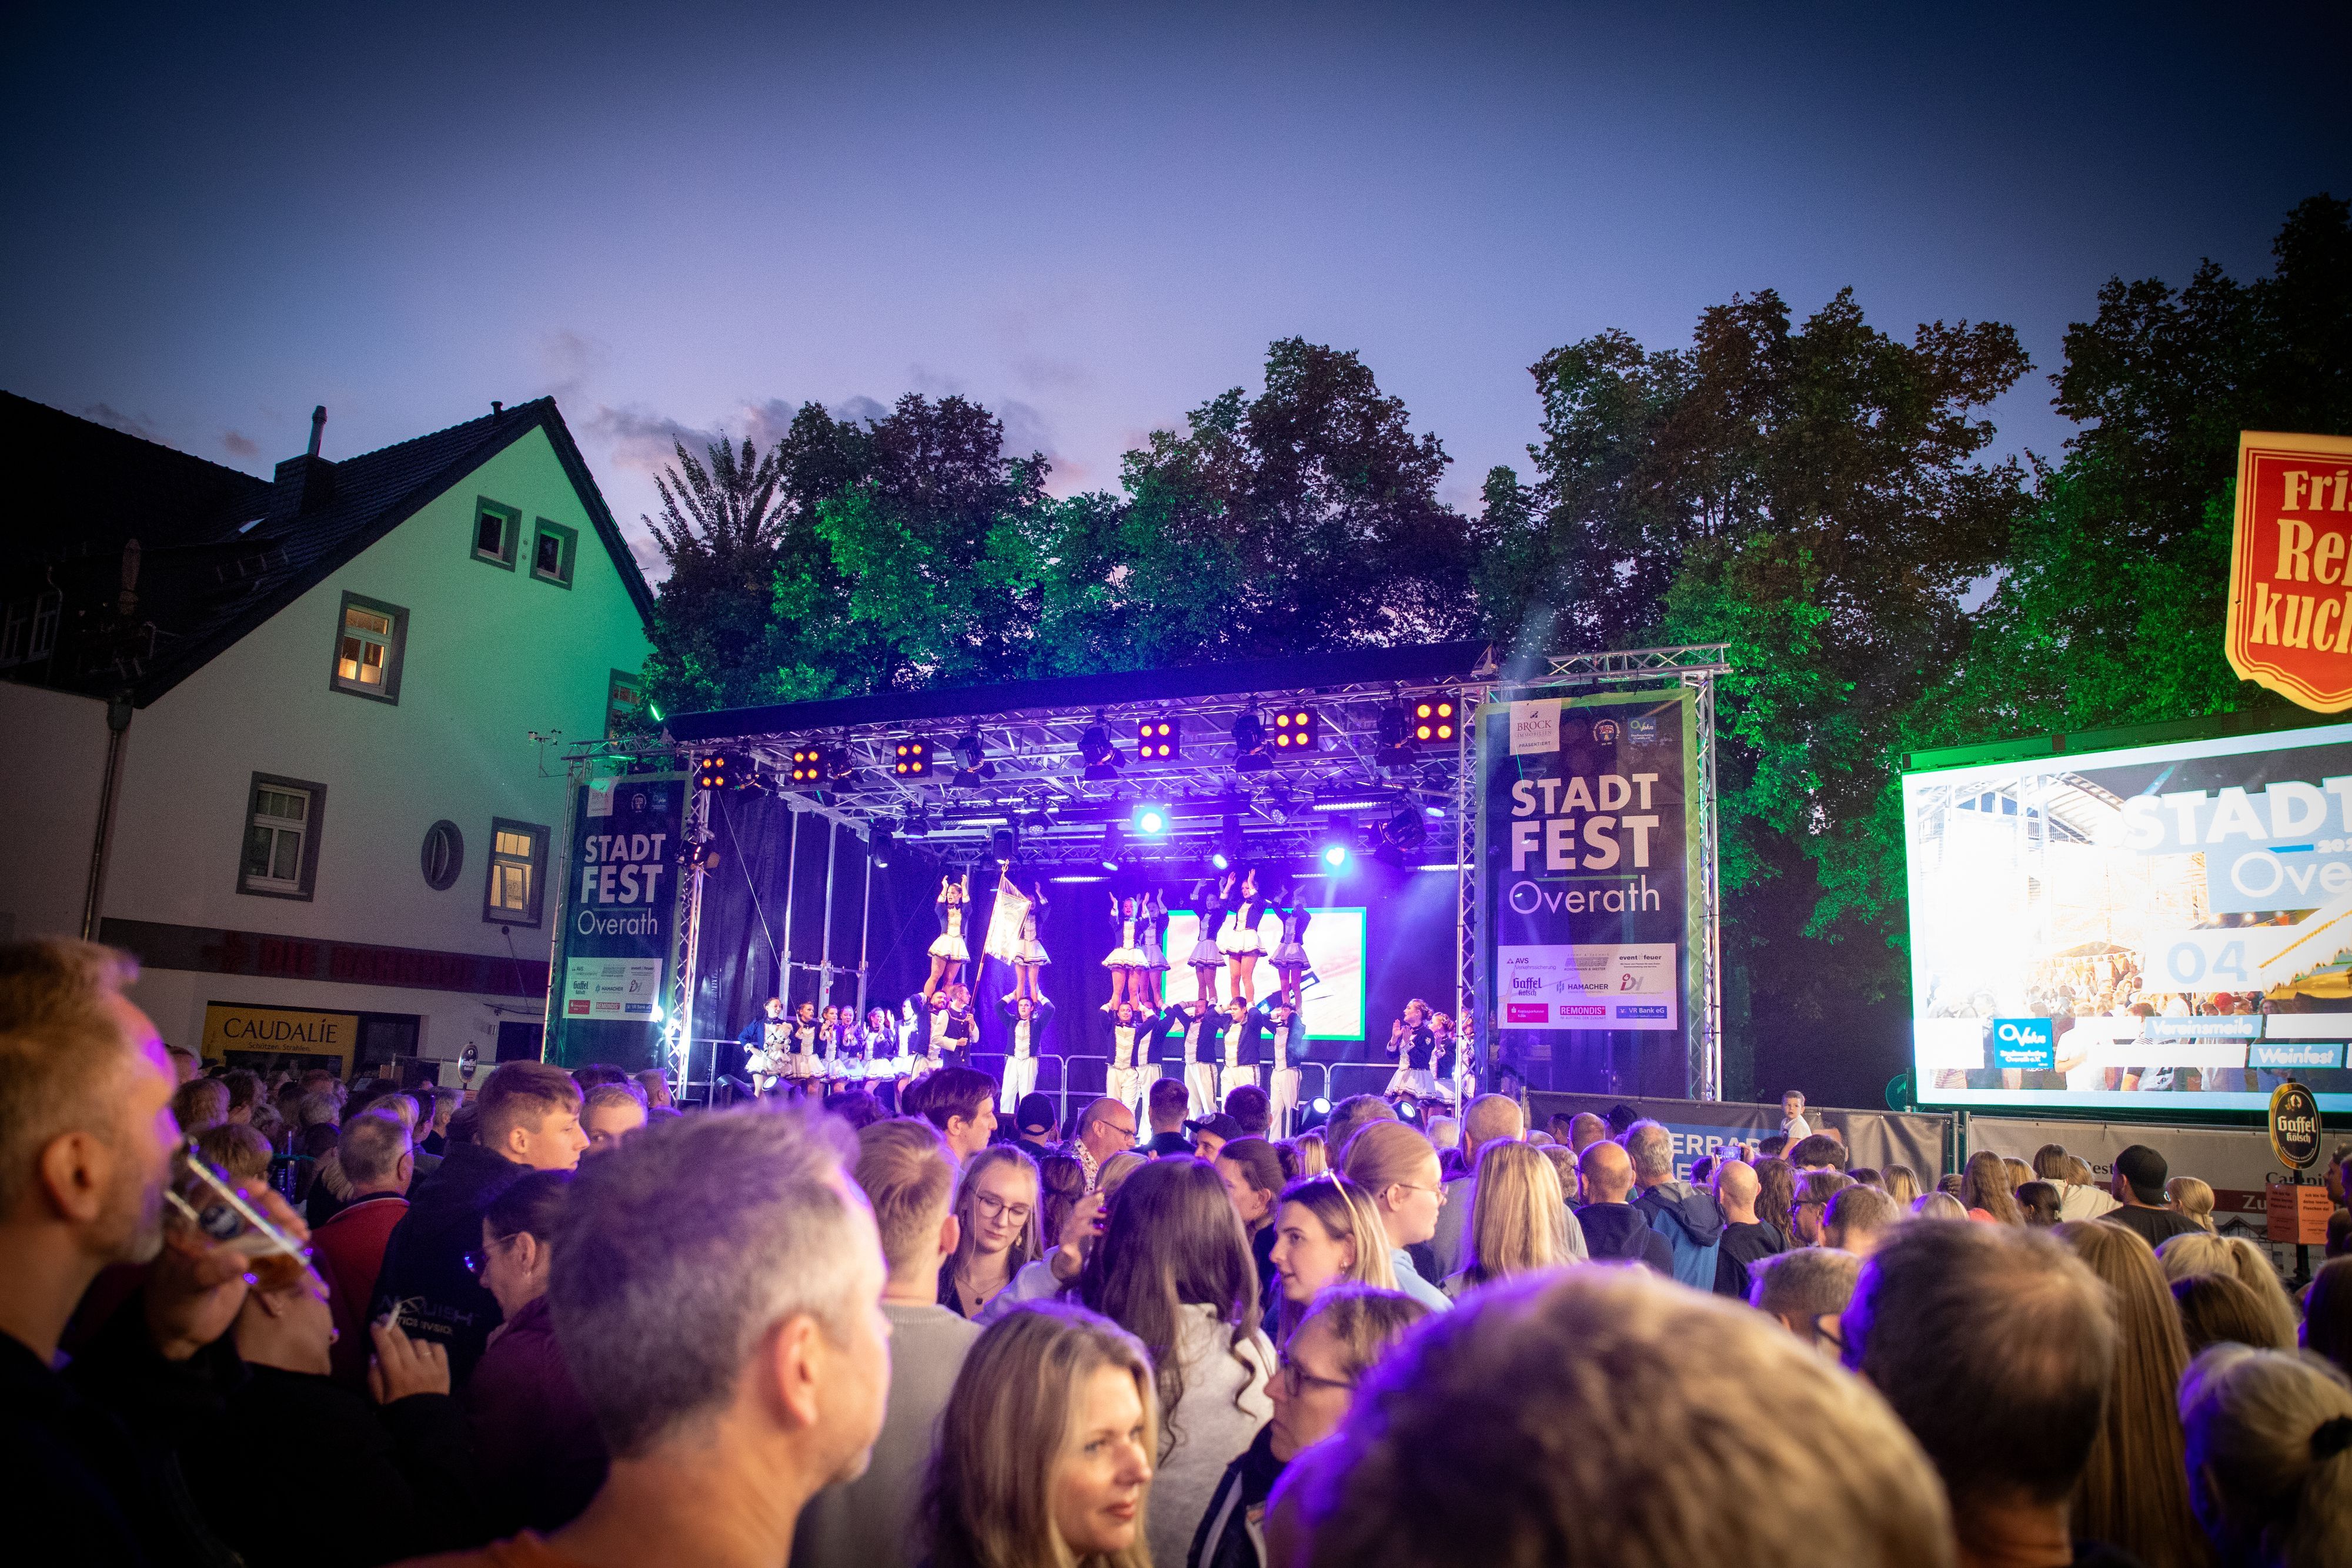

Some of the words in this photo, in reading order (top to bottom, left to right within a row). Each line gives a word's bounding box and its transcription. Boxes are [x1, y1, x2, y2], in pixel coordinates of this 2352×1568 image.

[2281, 469, 2352, 512] Fri
[1517, 720, 1552, 732] BROCK
[1511, 773, 1659, 817] STADT
[2122, 778, 2352, 850] STADT
[584, 834, 666, 862] STADT
[1511, 815, 1659, 871] FEST
[580, 864, 663, 904] FEST
[1509, 875, 1661, 915] Overath
[577, 908, 658, 935] Overath
[2167, 941, 2249, 984] 04
[573, 981, 589, 990] Gaffel
[1513, 977, 1542, 989] Gaffel
[1561, 1007, 1602, 1015] REMONDIS
[2151, 1017, 2254, 1036] Vereinsmeile
[248, 1042, 281, 1051] Schützen.
[2258, 1045, 2334, 1065] Weinfest
[2277, 1115, 2317, 1134] Gaffel
[2286, 1132, 2311, 1144] Kölsch
[2087, 1161, 2114, 1175] est
